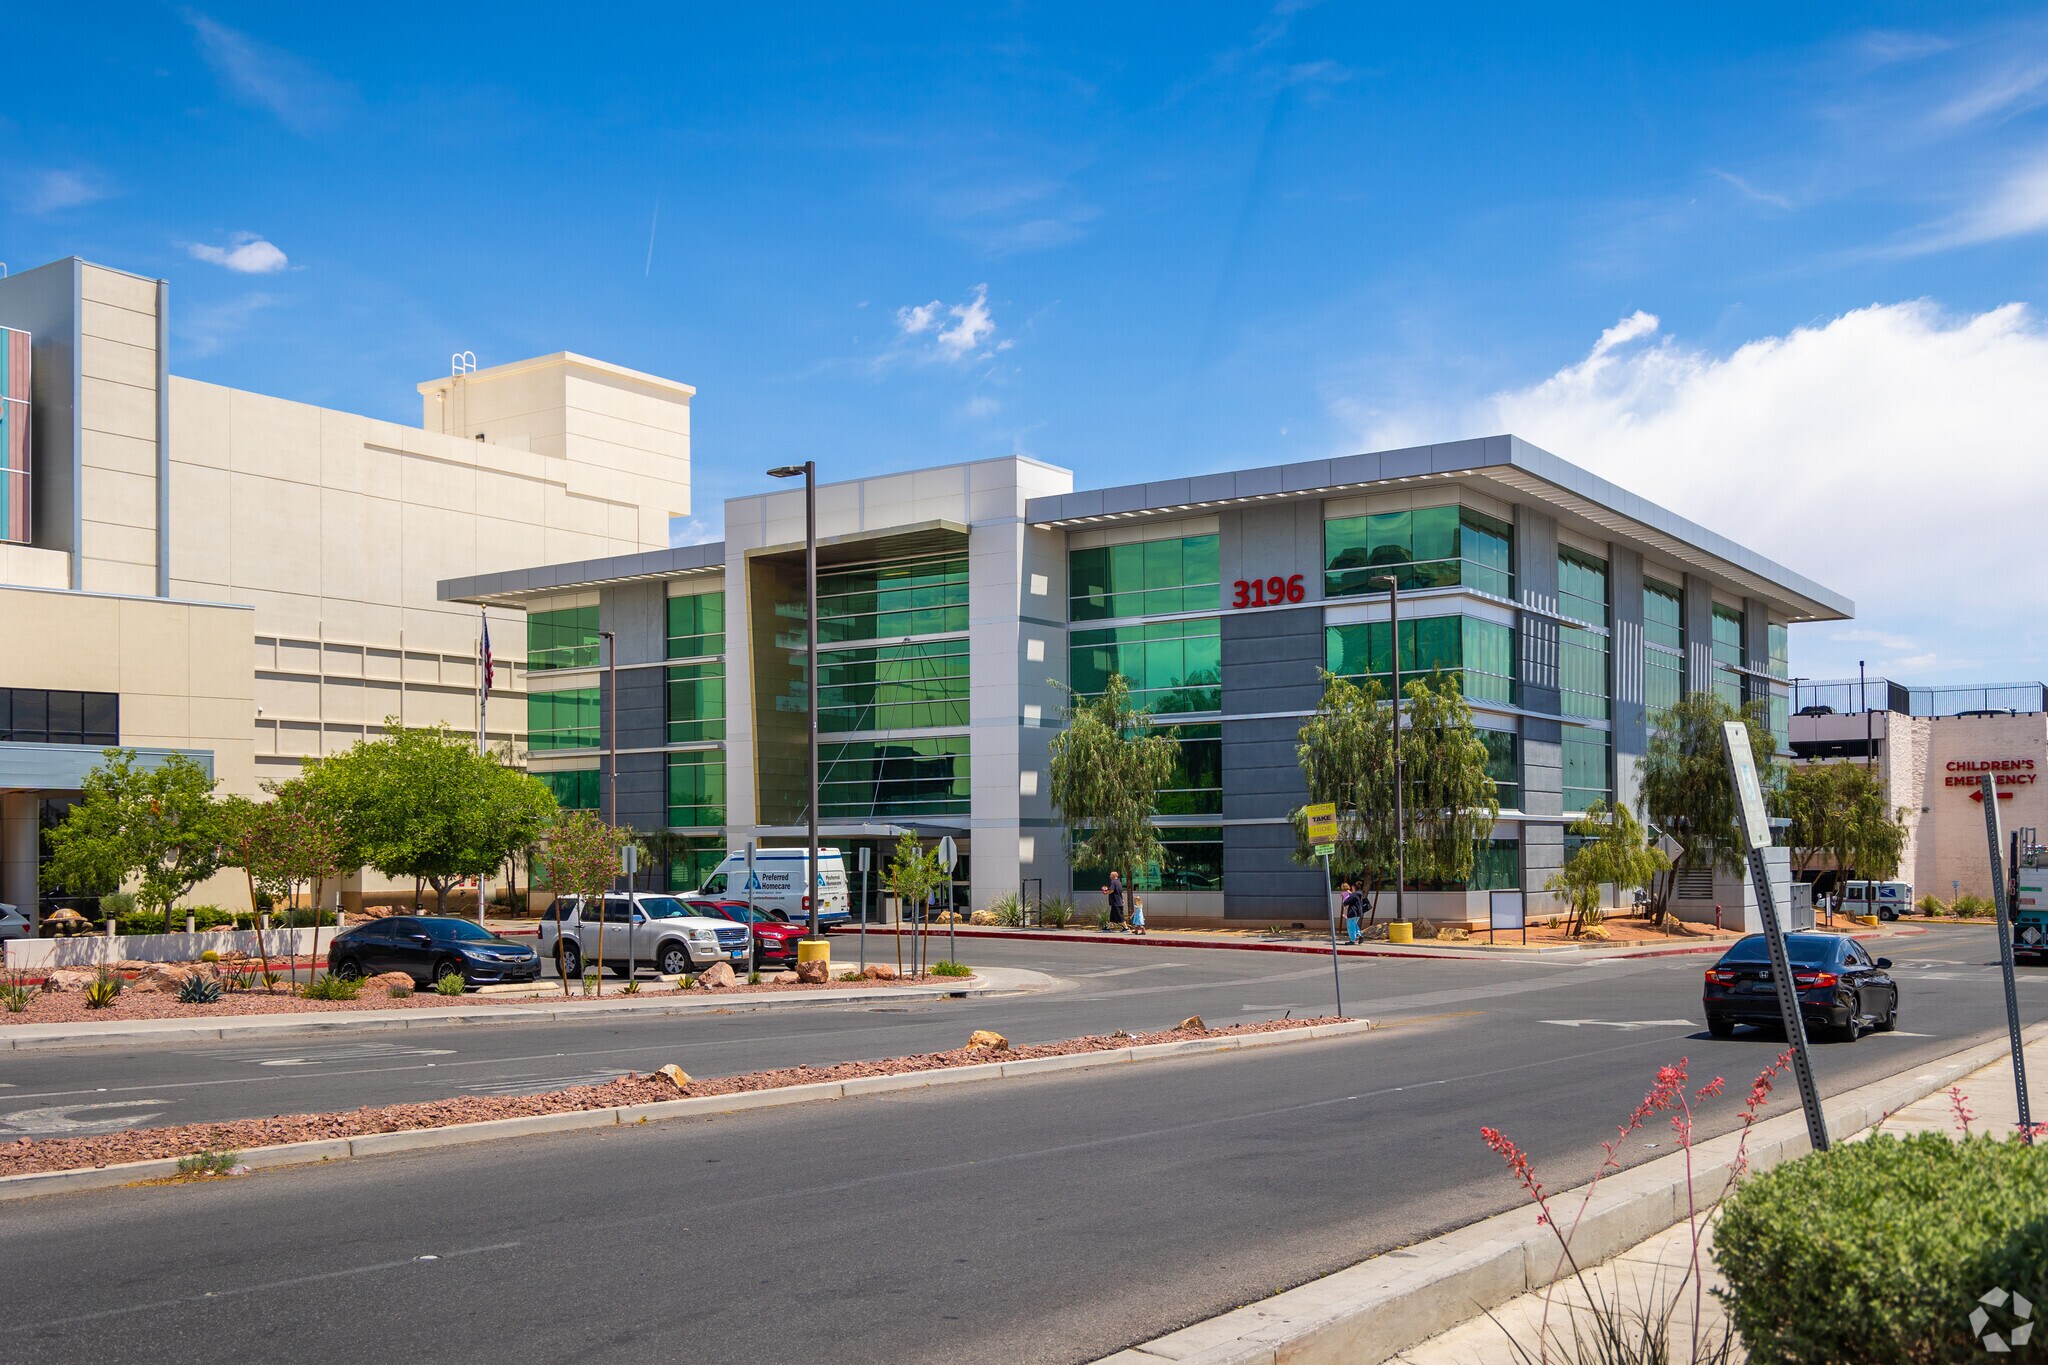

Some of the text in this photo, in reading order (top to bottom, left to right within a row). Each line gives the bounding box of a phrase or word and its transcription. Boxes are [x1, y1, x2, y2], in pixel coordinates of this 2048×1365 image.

[1232, 574, 1305, 608] 3196
[1946, 759, 2034, 771] CHILDREN'S
[1945, 774, 2037, 787] EMERENCY
[1310, 804, 1331, 812] LOCK
[1313, 825, 1332, 833] HIDE
[762, 873, 789, 881] Preferred
[761, 882, 791, 890] Homecare
